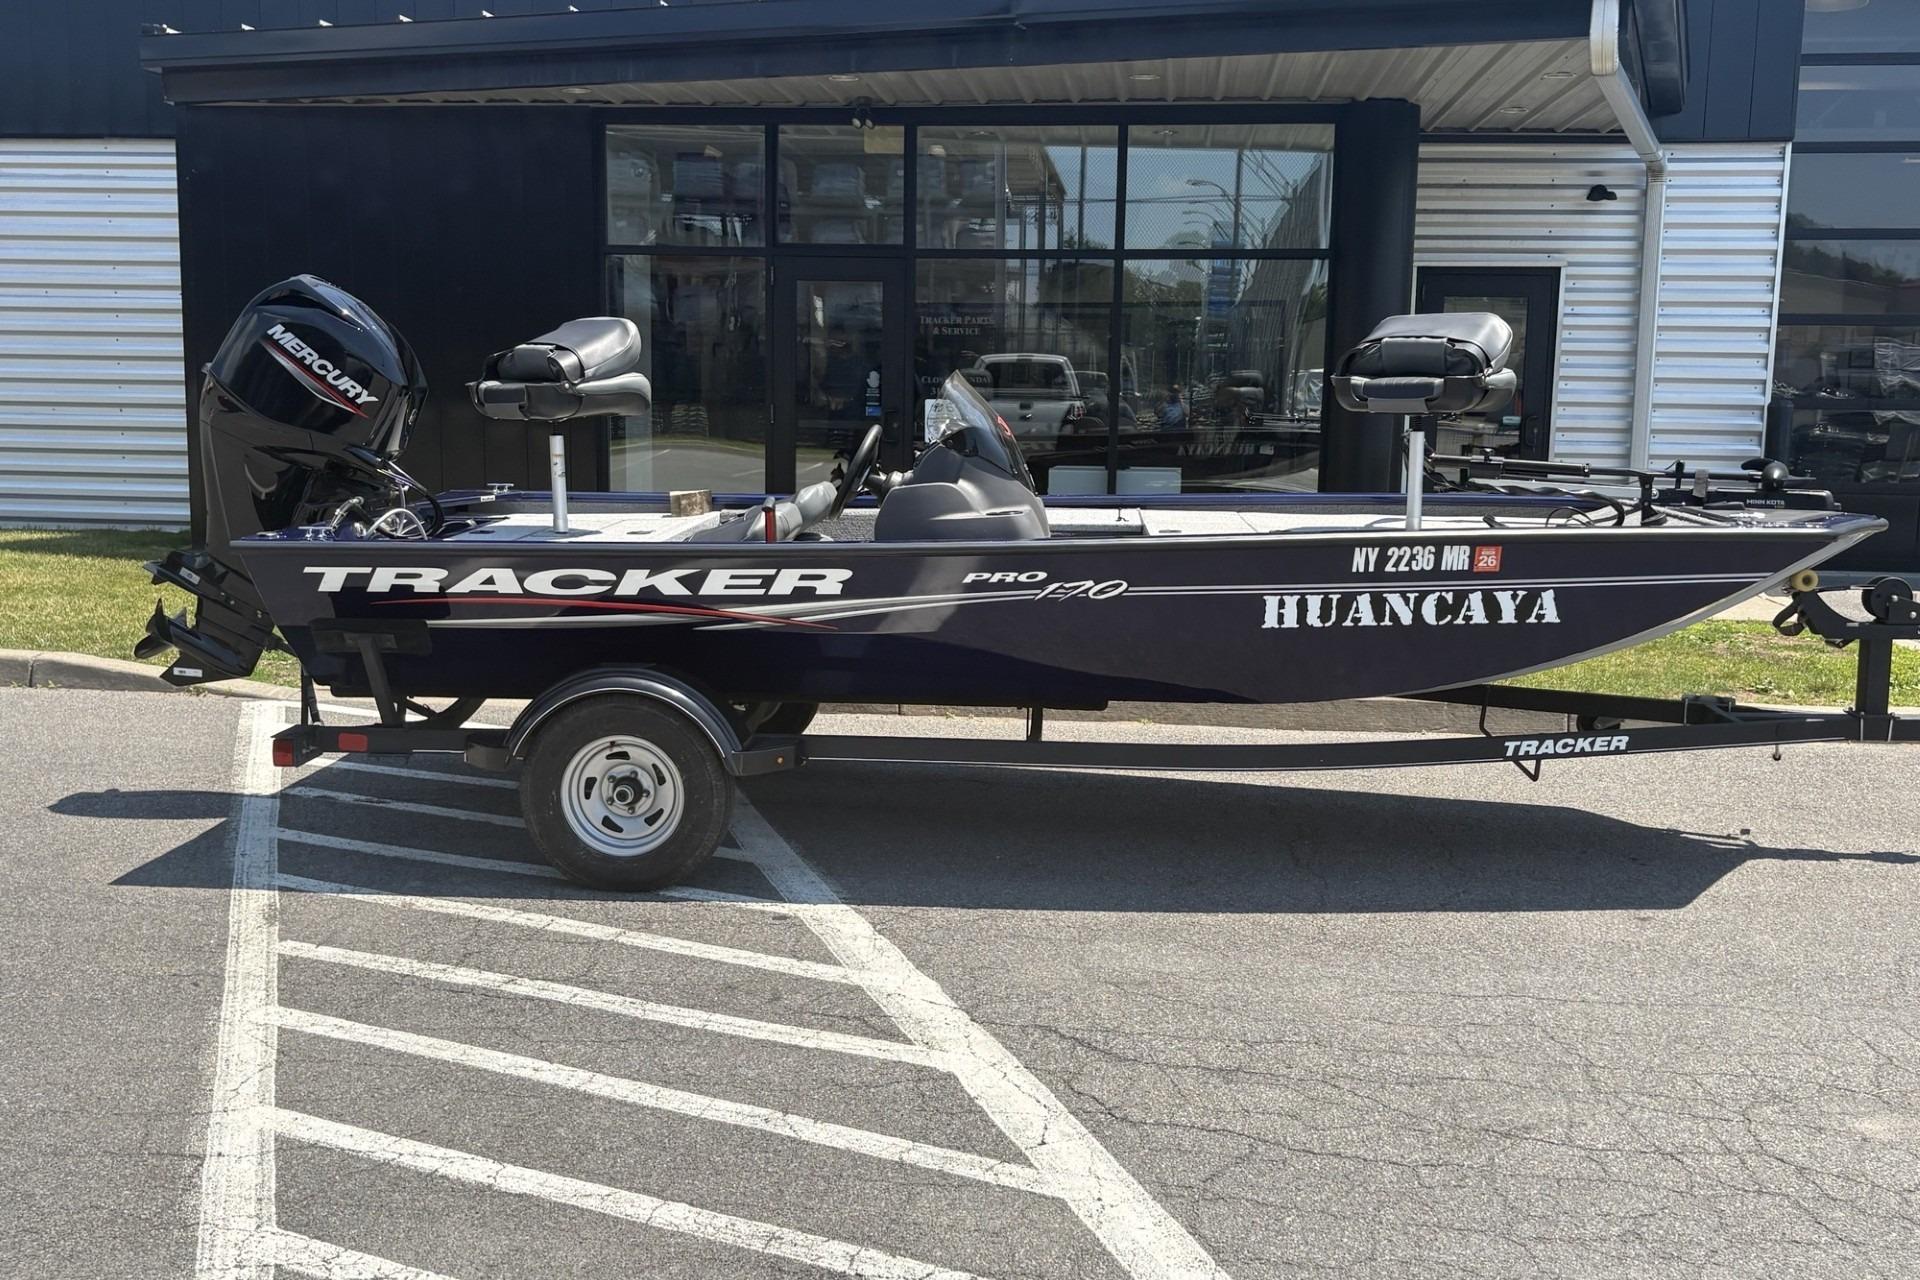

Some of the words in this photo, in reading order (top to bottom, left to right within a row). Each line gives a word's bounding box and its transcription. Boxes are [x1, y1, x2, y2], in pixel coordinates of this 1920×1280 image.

[920, 315, 962, 325] TRACKER
[964, 315, 995, 325] PARTS
[942, 326, 980, 336] SERVICE
[266, 323, 380, 405] MERCURY
[1351, 547, 1379, 573] NY
[1384, 547, 1436, 572] 2236
[1441, 546, 1471, 571] MR
[1477, 555, 1497, 567] 26
[303, 566, 853, 596] TRACKER
[962, 571, 1048, 583] PRO
[1034, 580, 1128, 602] 170
[1261, 589, 1561, 629] HUANCAYA
[1504, 736, 1629, 756] TRACKER
